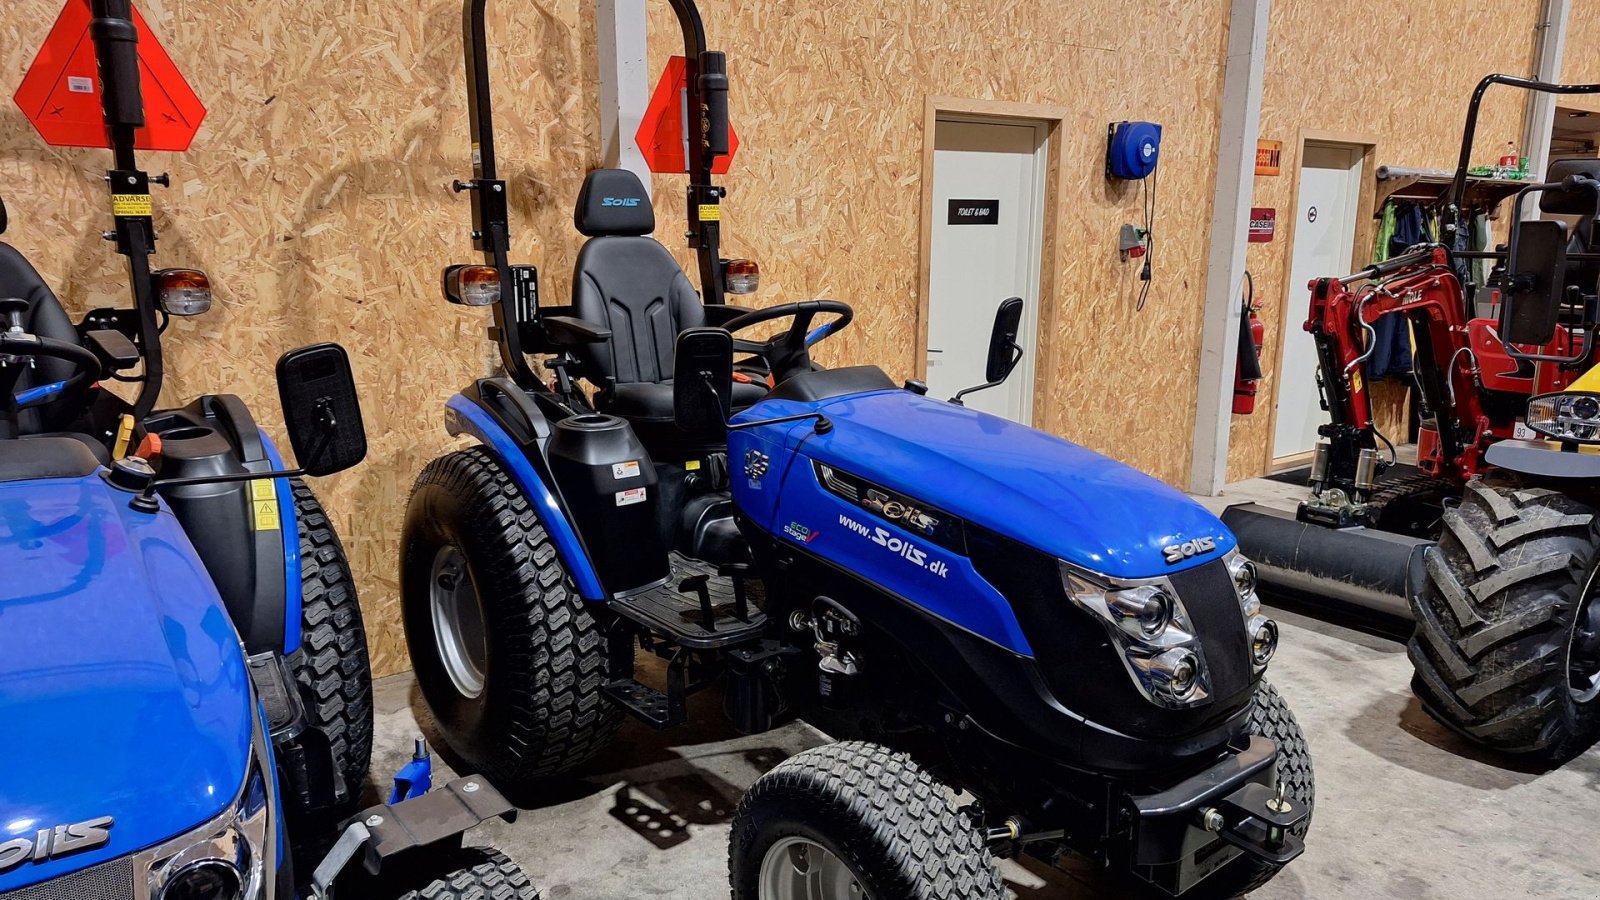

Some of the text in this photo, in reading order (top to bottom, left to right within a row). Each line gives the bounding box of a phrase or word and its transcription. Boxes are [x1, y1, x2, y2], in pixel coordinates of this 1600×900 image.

[957, 207, 976, 216] TOILET
[978, 207, 990, 216] BAD
[1250, 220, 1267, 228] CASE
